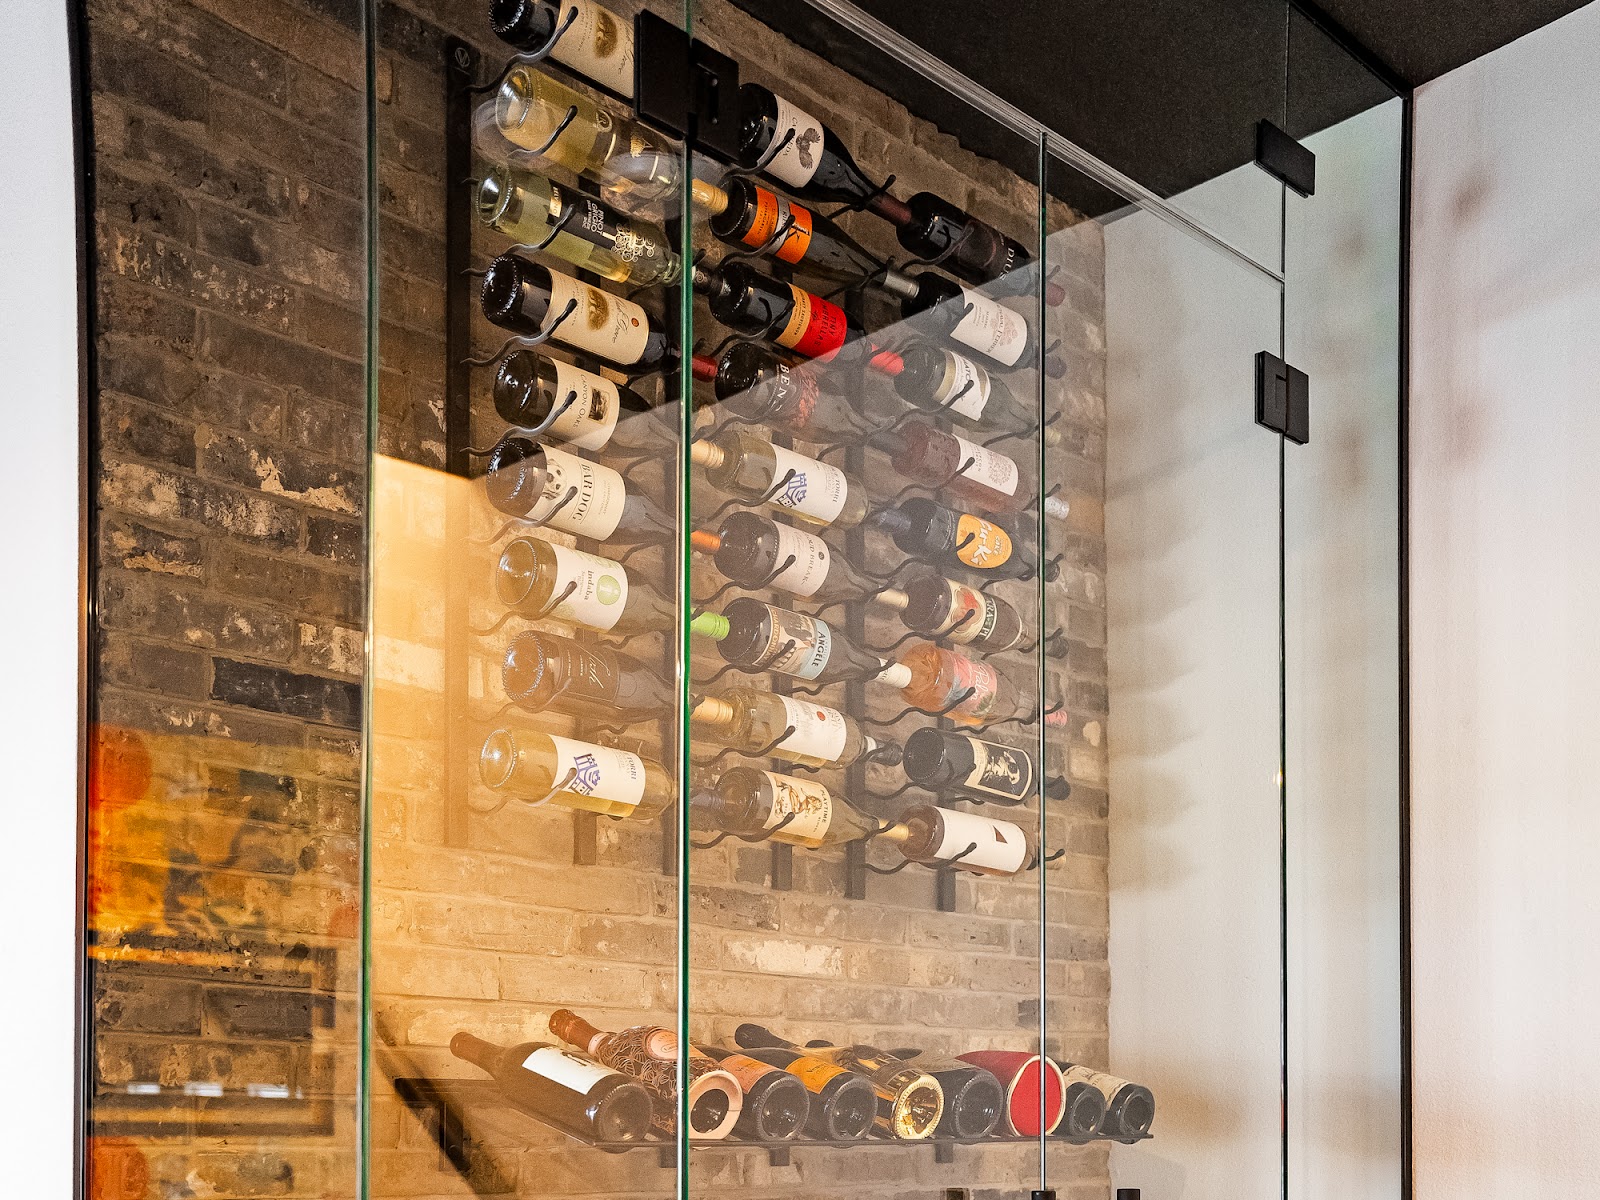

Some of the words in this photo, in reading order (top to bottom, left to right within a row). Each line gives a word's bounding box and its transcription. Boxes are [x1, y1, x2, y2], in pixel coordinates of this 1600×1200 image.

[597, 208, 605, 235] PINOT
[830, 315, 838, 336] TINY
[580, 374, 589, 405] CANYON
[572, 406, 587, 428] OAKS
[581, 463, 593, 493] BAR
[572, 495, 592, 521] DOG
[801, 556, 816, 586] BREAK
[812, 631, 827, 668] ANGELE
[820, 789, 828, 824] PLAYTIME
